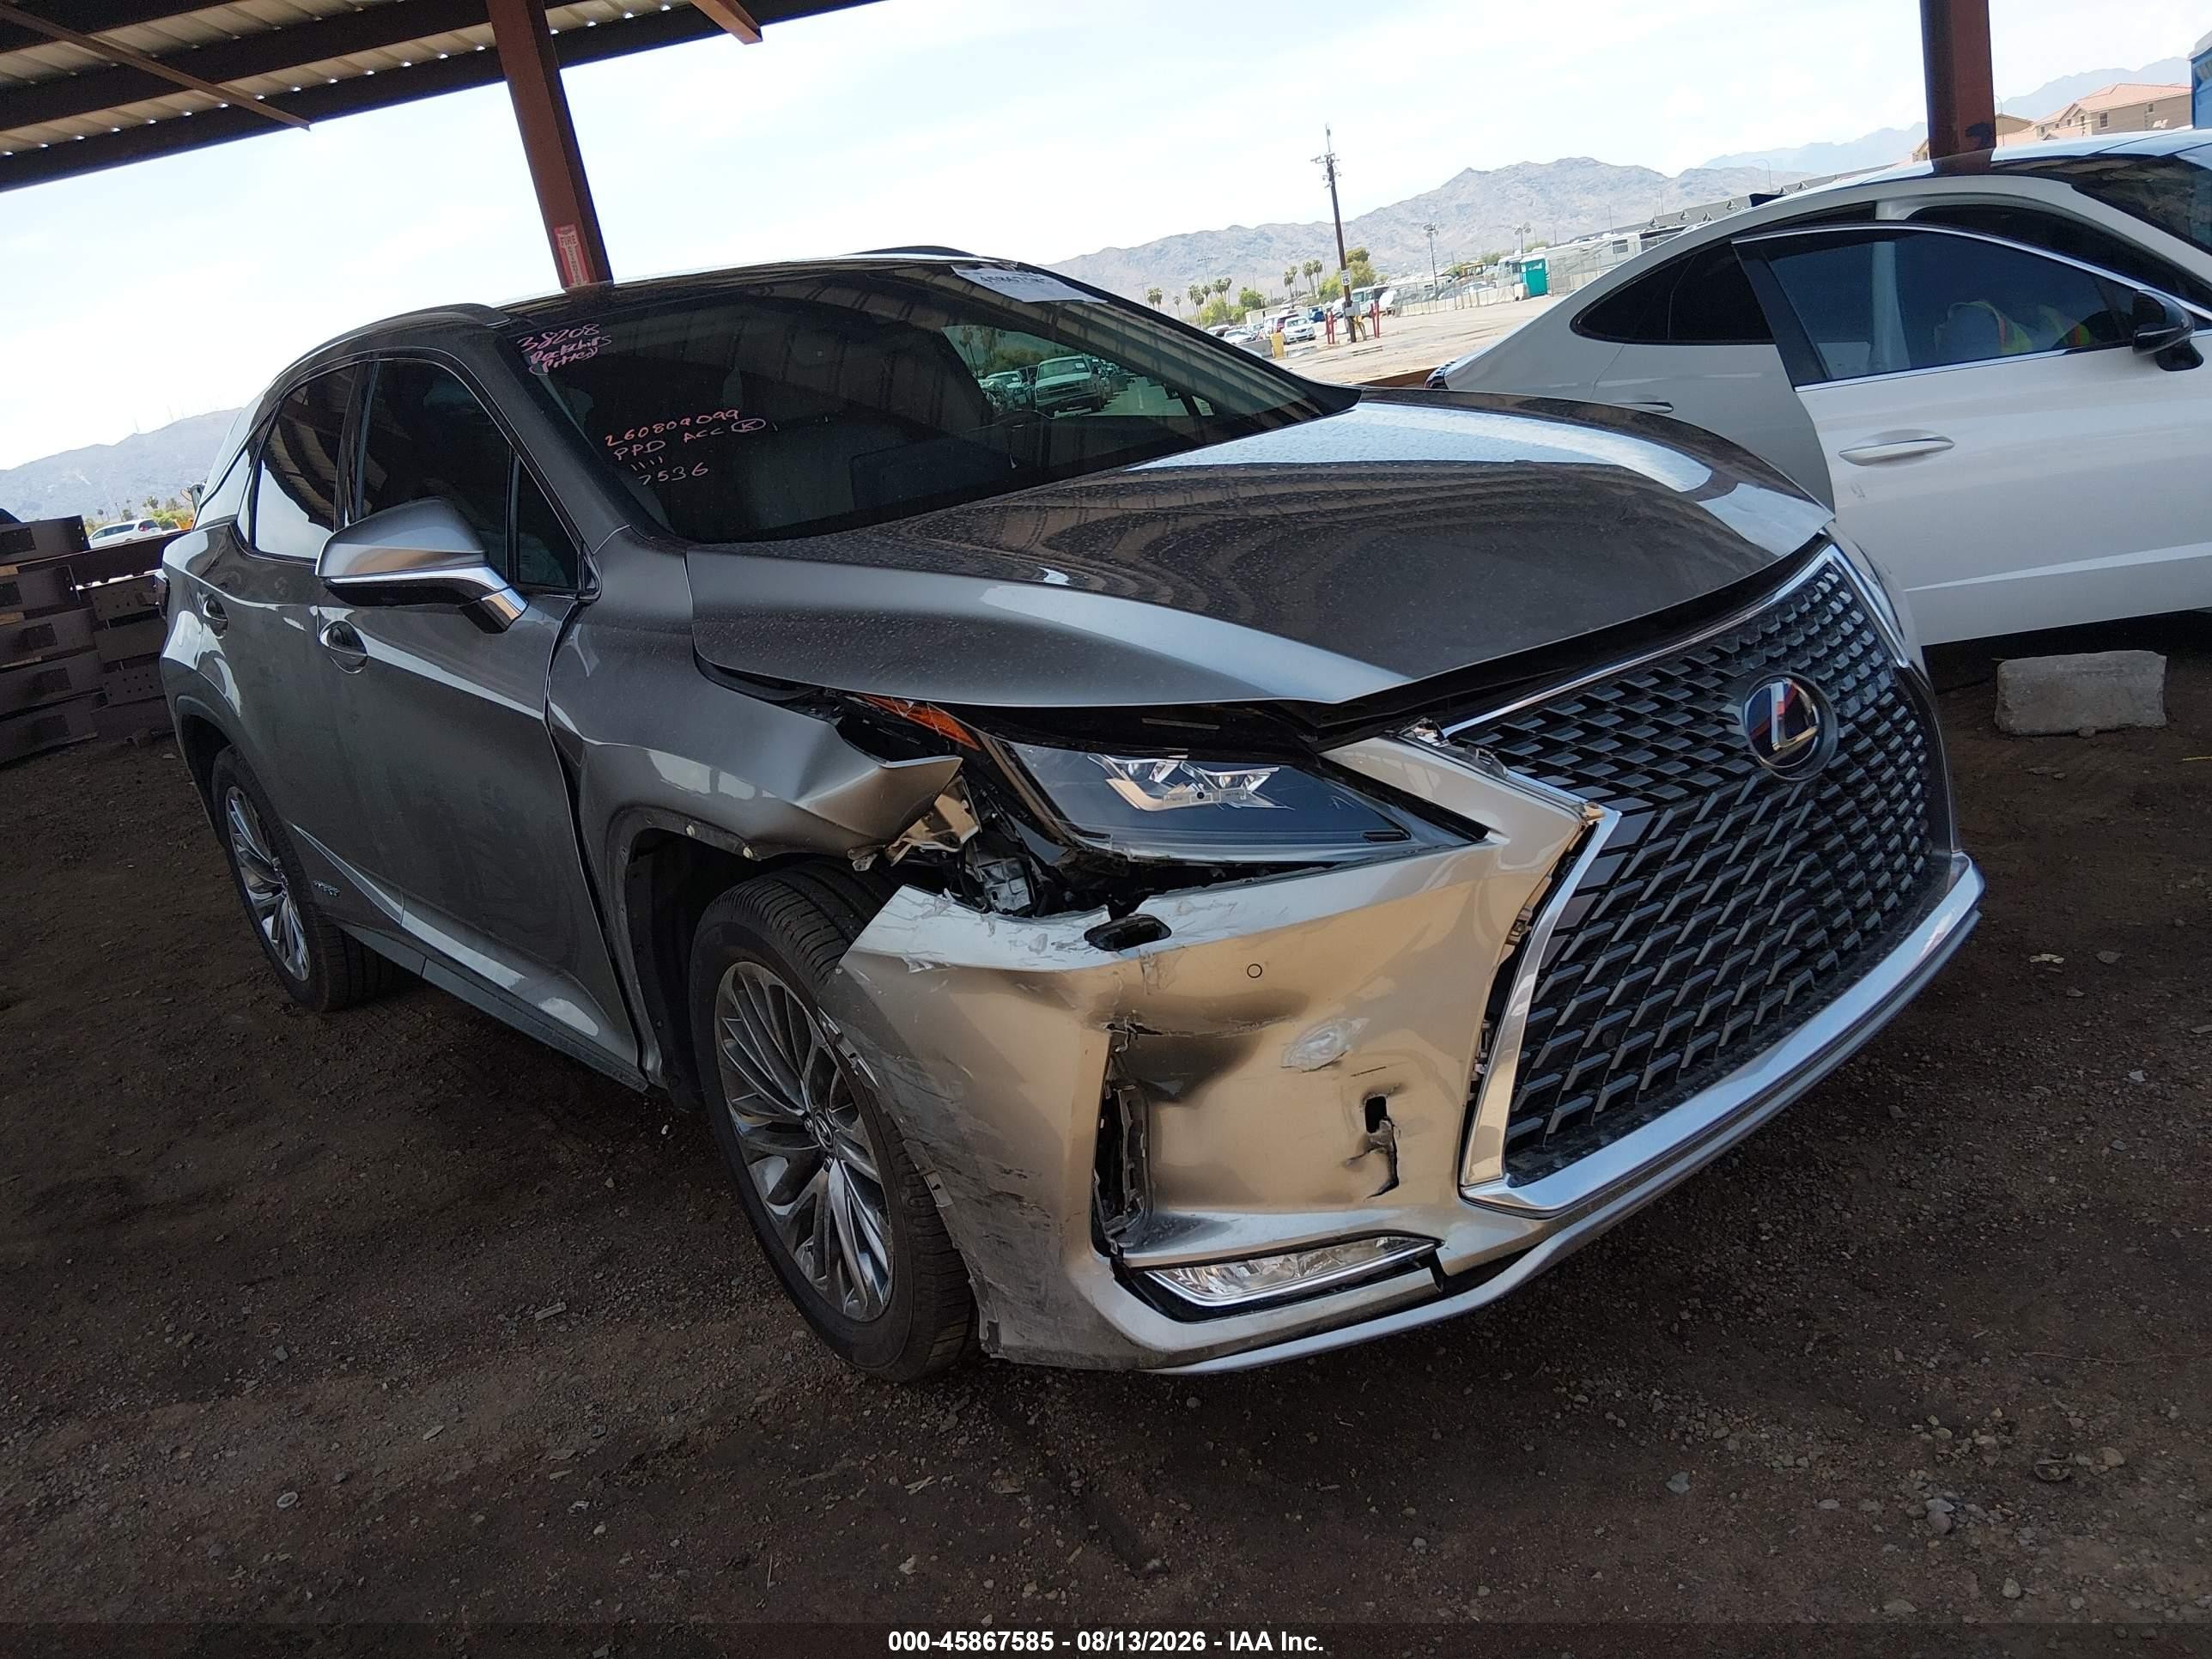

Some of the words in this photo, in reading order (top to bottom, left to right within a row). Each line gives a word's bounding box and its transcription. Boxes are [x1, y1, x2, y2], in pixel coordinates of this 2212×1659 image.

[561, 234, 577, 247] FIRE
[516, 324, 600, 353] 38208
[639, 462, 708, 485] 7536
